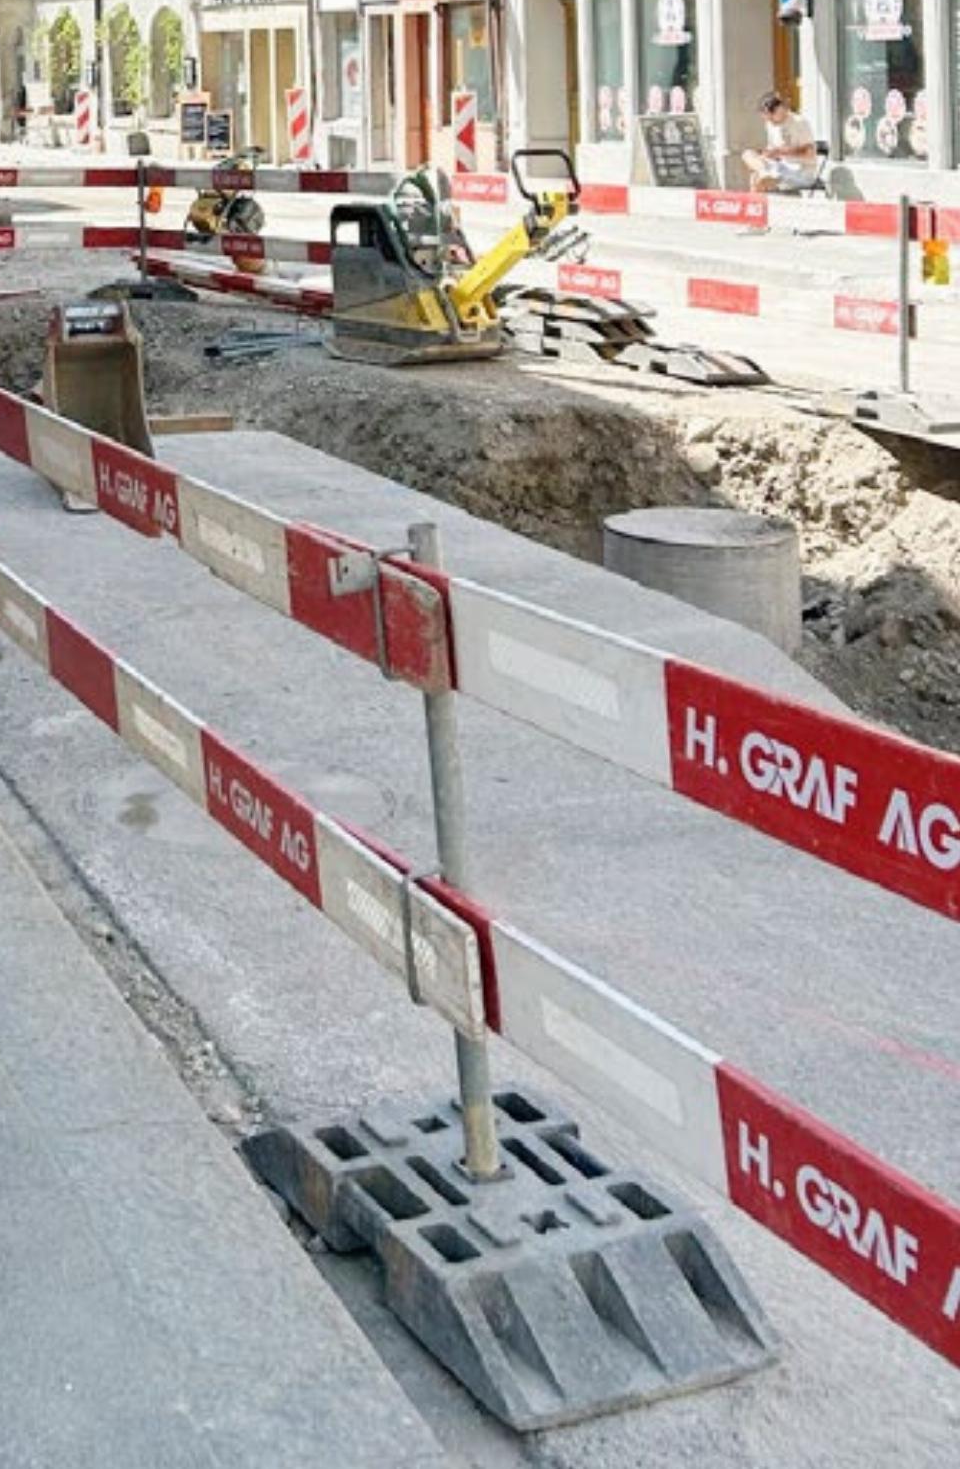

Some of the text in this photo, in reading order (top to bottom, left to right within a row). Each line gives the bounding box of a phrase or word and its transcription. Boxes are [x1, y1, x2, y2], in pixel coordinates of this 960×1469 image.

[115, 471, 147, 513] GRAF
[152, 489, 176, 530] AG
[209, 760, 311, 873] H. GRAF AG
[685, 706, 960, 871] H. GRAF AG
[739, 1117, 919, 1287] H. GRAF
